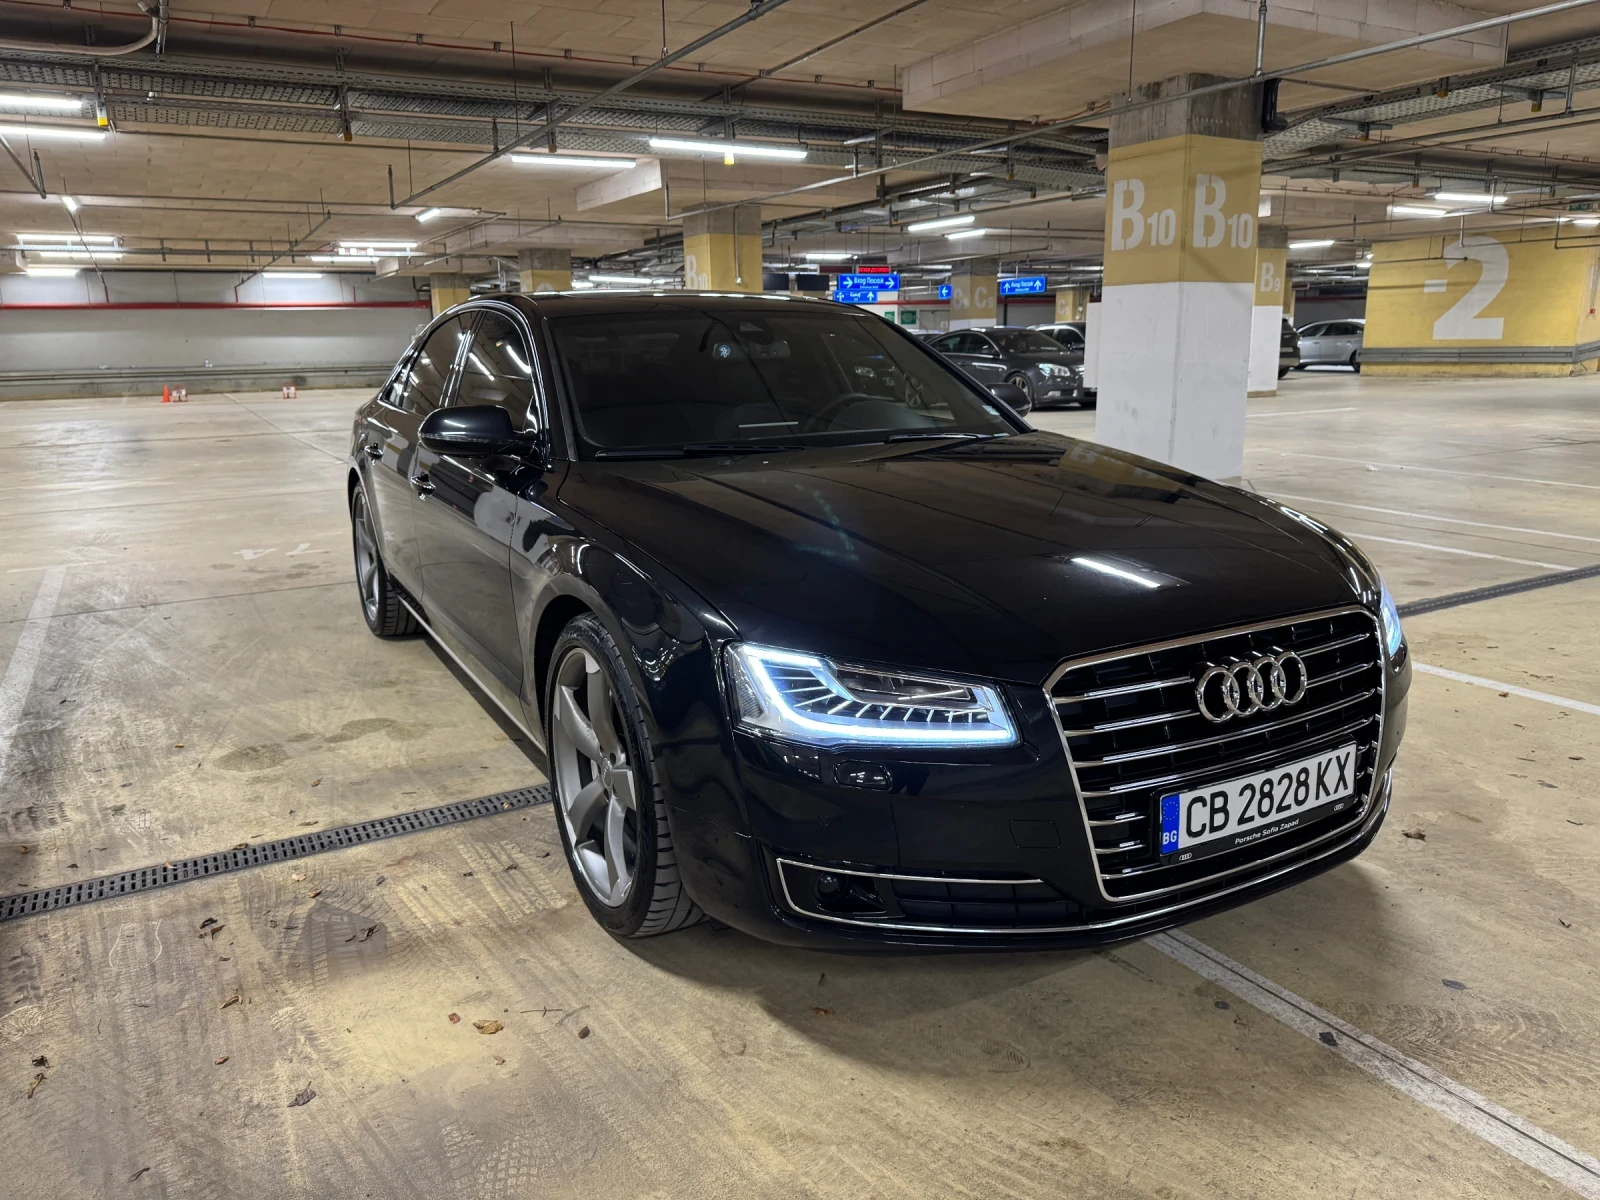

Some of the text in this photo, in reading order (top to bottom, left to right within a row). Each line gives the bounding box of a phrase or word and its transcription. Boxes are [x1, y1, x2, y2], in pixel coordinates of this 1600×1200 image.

[1259, 262, 1281, 292] B9
[1185, 751, 1350, 839] CB 2828 KX
[1162, 829, 1178, 845] BG
[1234, 818, 1300, 845] Porsche Sofia Zapad
